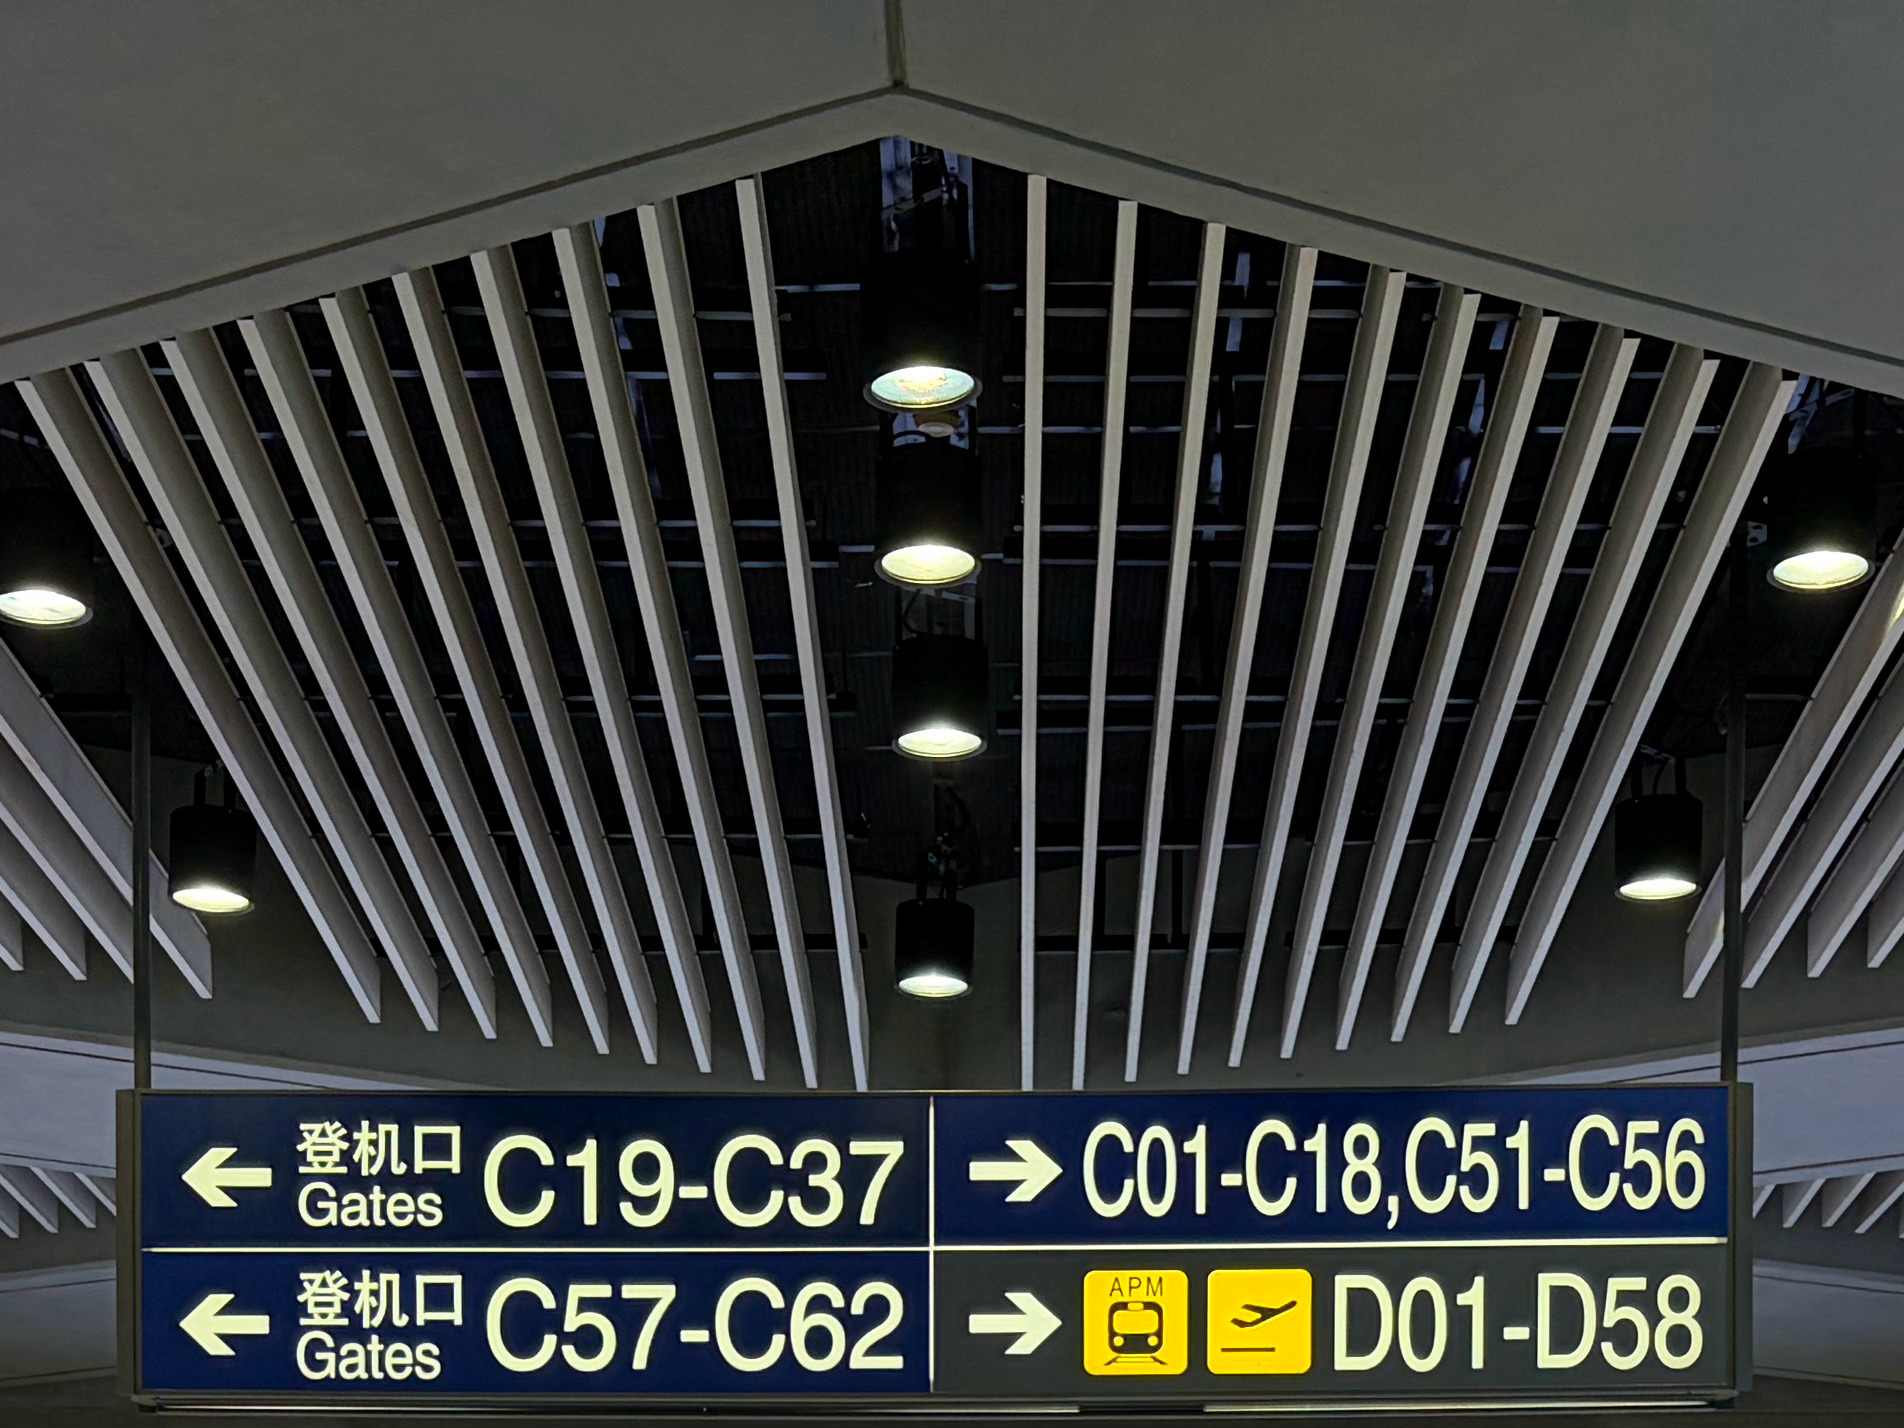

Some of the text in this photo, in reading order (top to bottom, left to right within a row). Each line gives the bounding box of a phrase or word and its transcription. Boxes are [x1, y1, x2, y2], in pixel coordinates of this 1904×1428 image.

[296, 1120, 462, 1176] 登机口
[1083, 1114, 1706, 1230] C01-C18,C51-C56
[297, 1181, 444, 1228] Gates
[484, 1134, 904, 1228] C19-C37
[296, 1269, 463, 1329] 登机口
[1109, 1276, 1165, 1298] APM
[486, 1277, 905, 1373] C57-C62
[1334, 1271, 1704, 1373] D01-D58
[296, 1330, 442, 1381] Gates
